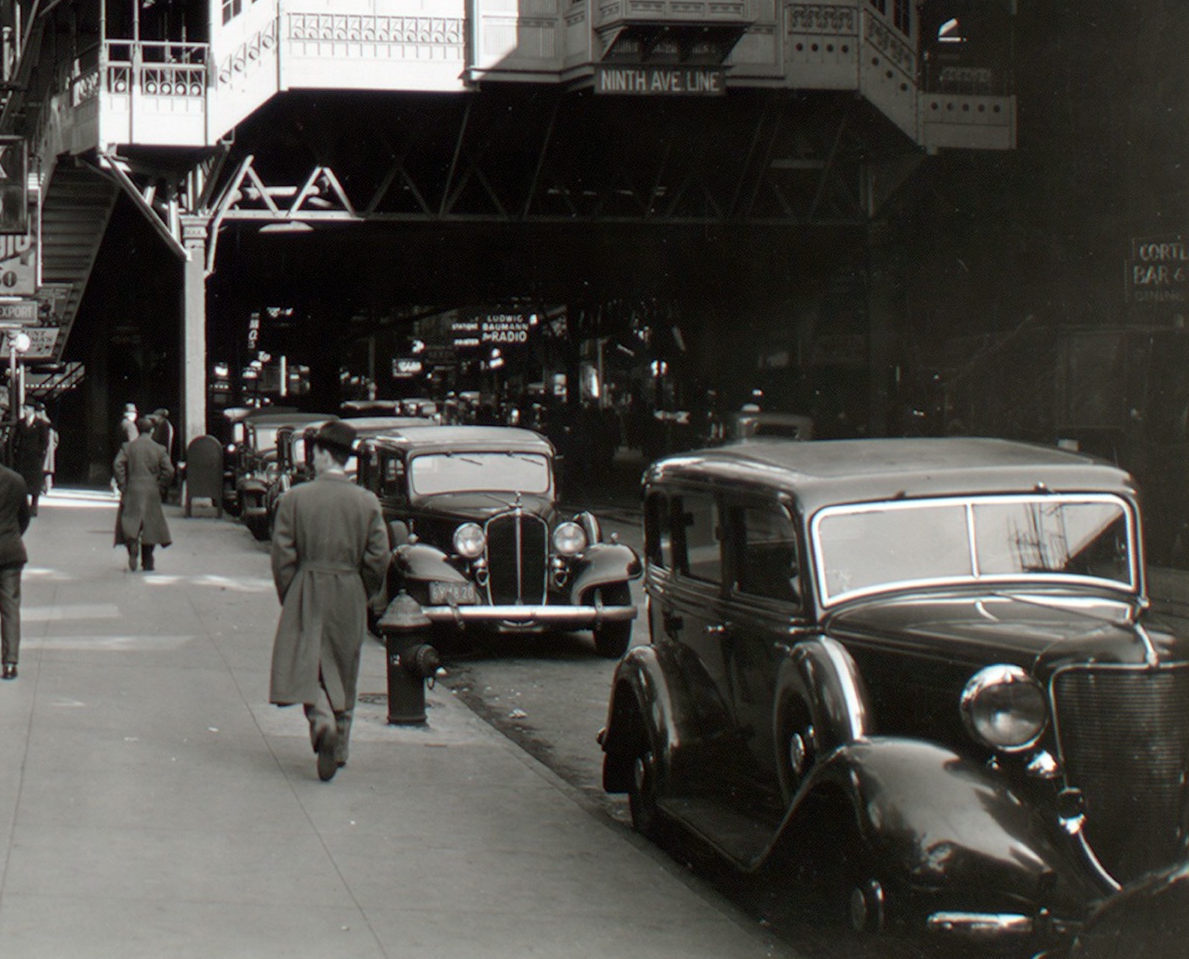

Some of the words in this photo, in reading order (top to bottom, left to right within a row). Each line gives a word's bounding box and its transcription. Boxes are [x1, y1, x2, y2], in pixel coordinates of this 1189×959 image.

[601, 70, 646, 91] NINTH
[687, 72, 720, 92] LINE
[1134, 265, 1169, 284] BAR
[487, 314, 523, 323] LUDWIG
[482, 323, 529, 331] BAUMANN
[492, 331, 527, 342] RADIO
